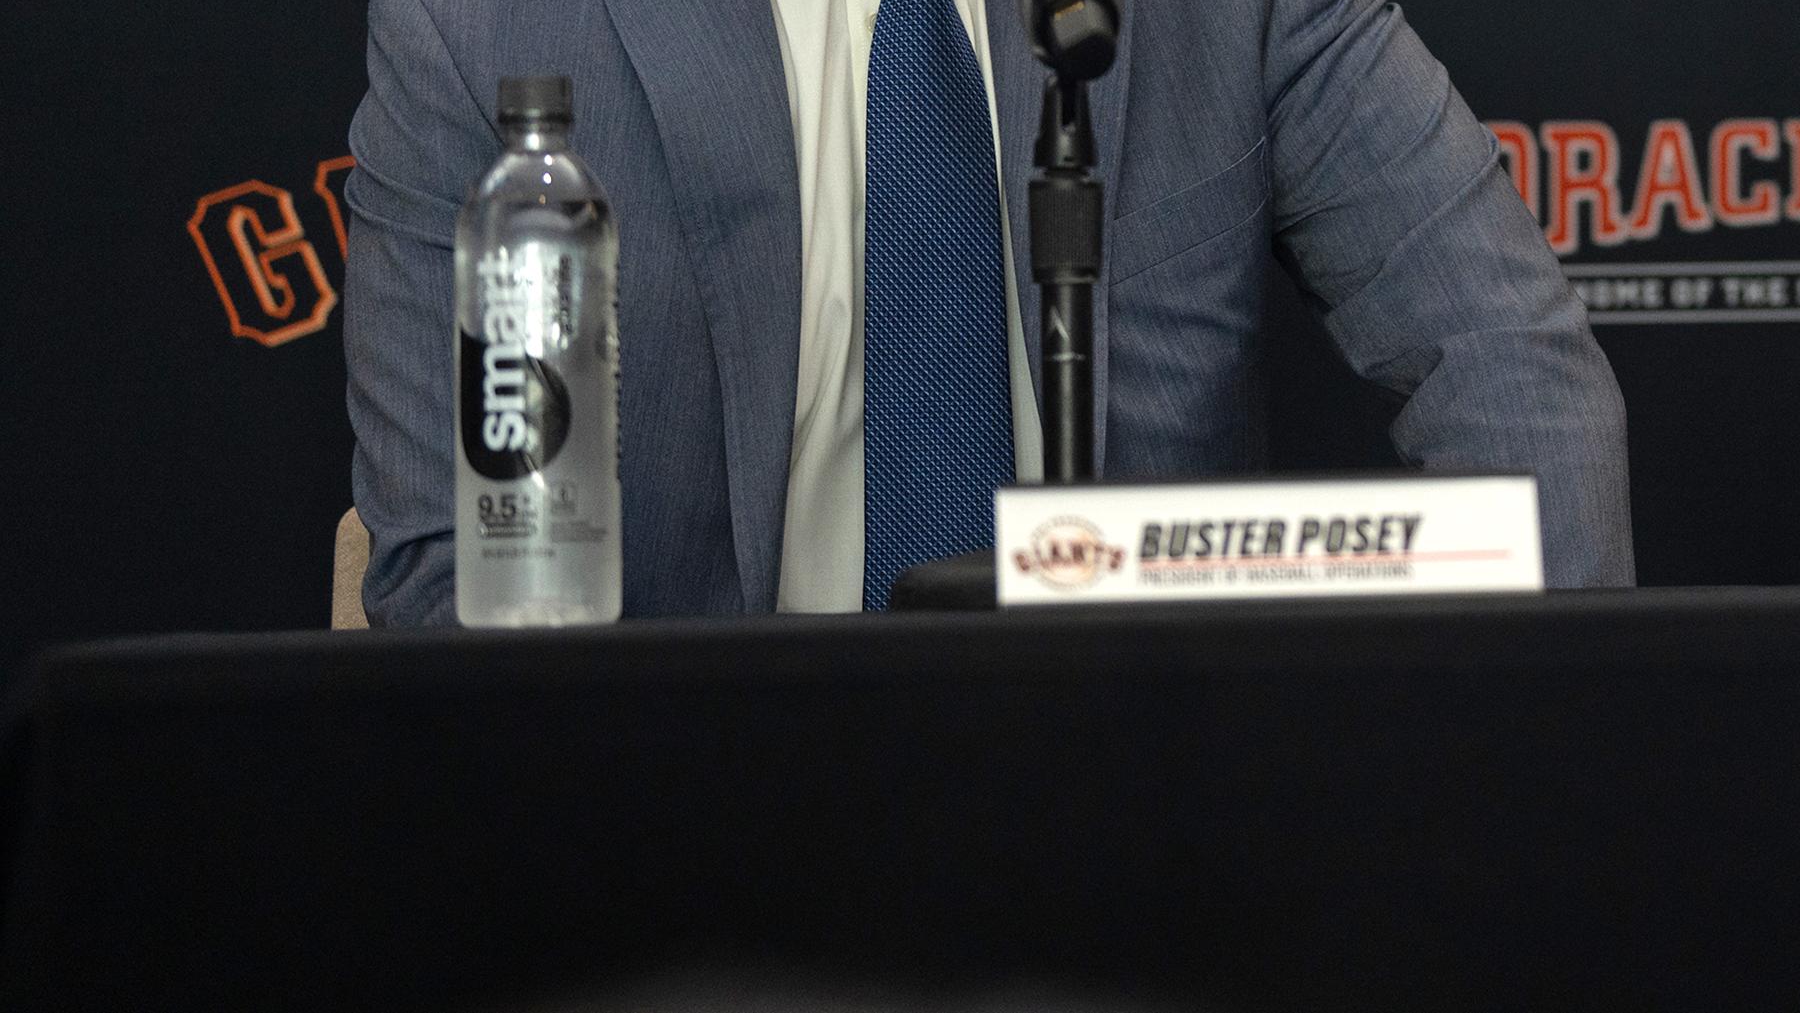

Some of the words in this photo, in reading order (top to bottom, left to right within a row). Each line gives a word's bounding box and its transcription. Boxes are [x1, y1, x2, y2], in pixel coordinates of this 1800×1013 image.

[476, 245, 527, 452] smart
[1137, 521, 1288, 560] BUSTER
[1294, 512, 1422, 557] POSEY
